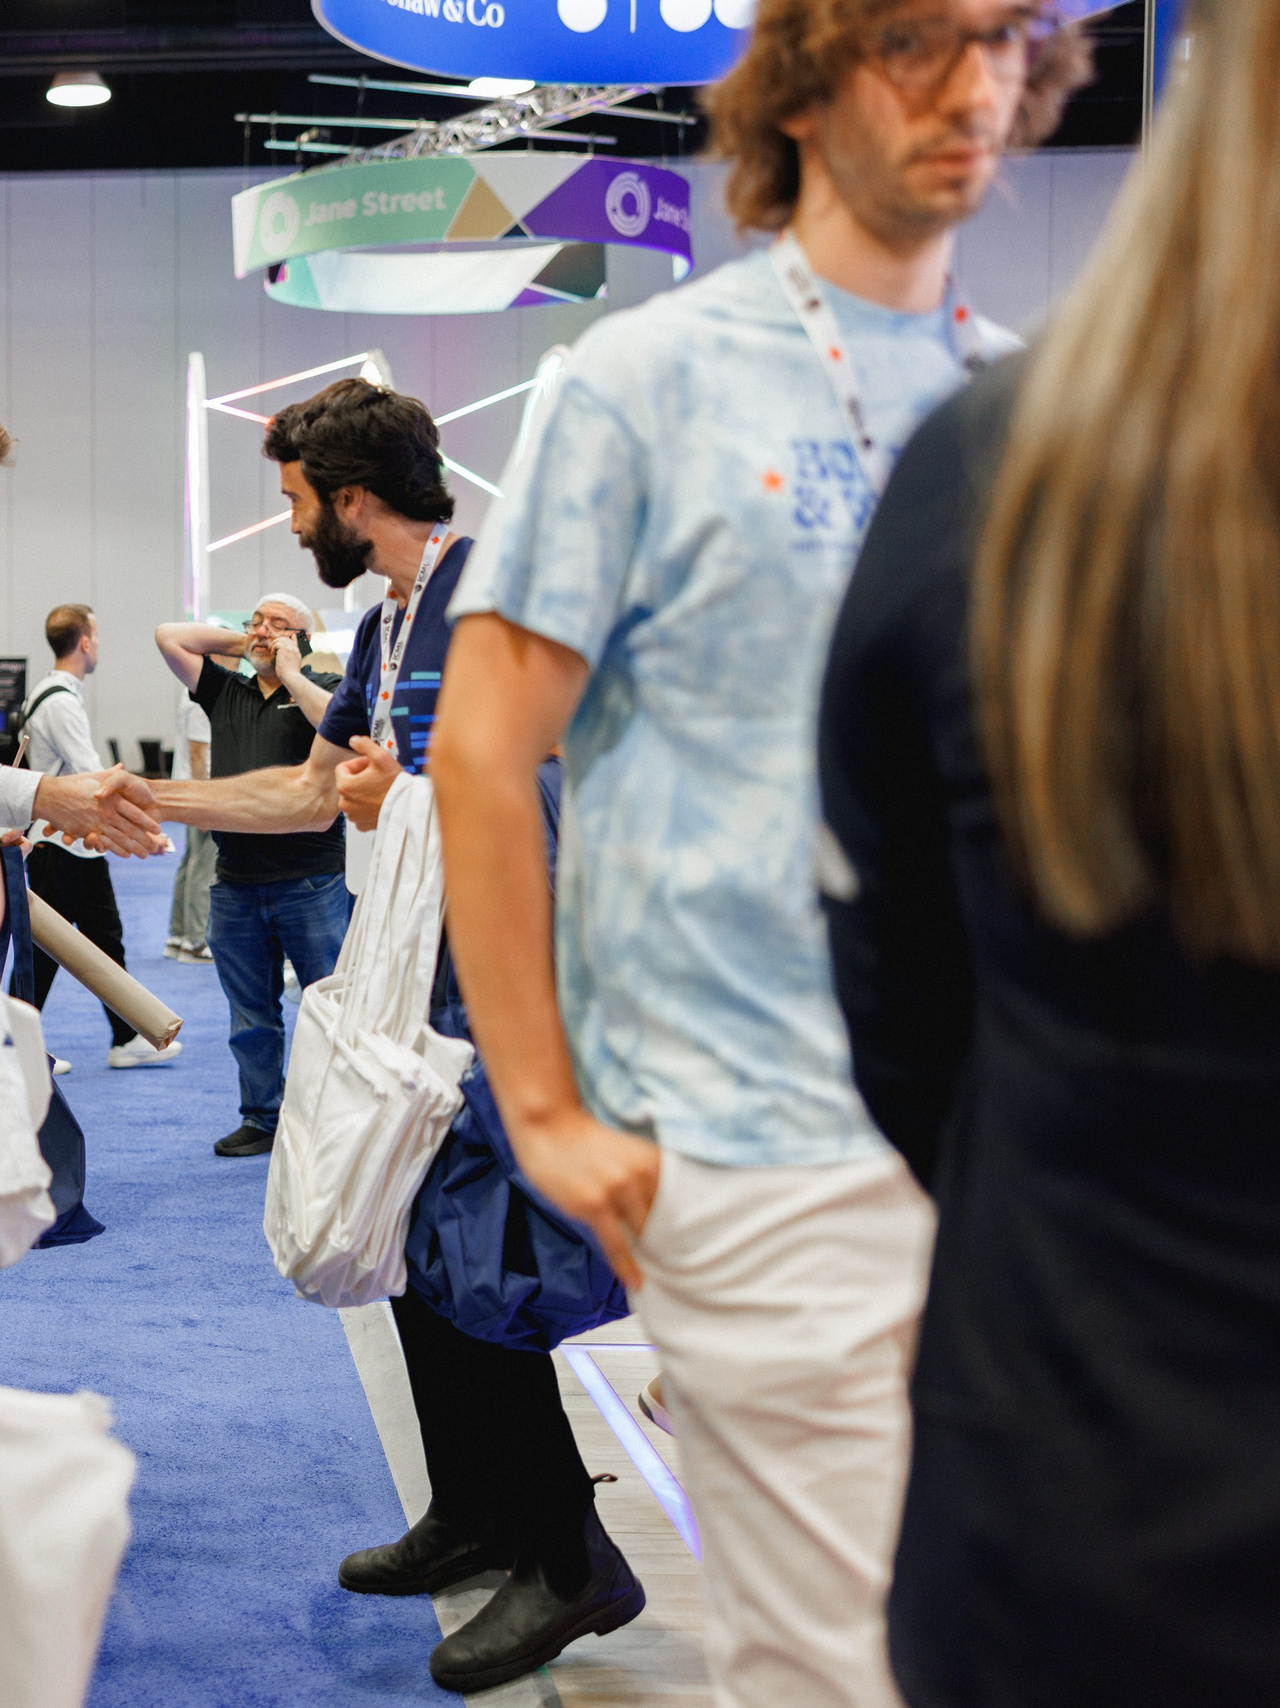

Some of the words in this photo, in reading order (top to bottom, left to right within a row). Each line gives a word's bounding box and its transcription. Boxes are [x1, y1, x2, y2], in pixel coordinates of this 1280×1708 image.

[304, 200, 357, 226] Jane
[362, 187, 445, 217] Street
[417, 562, 431, 582] ICML
[392, 641, 403, 660] ICML
